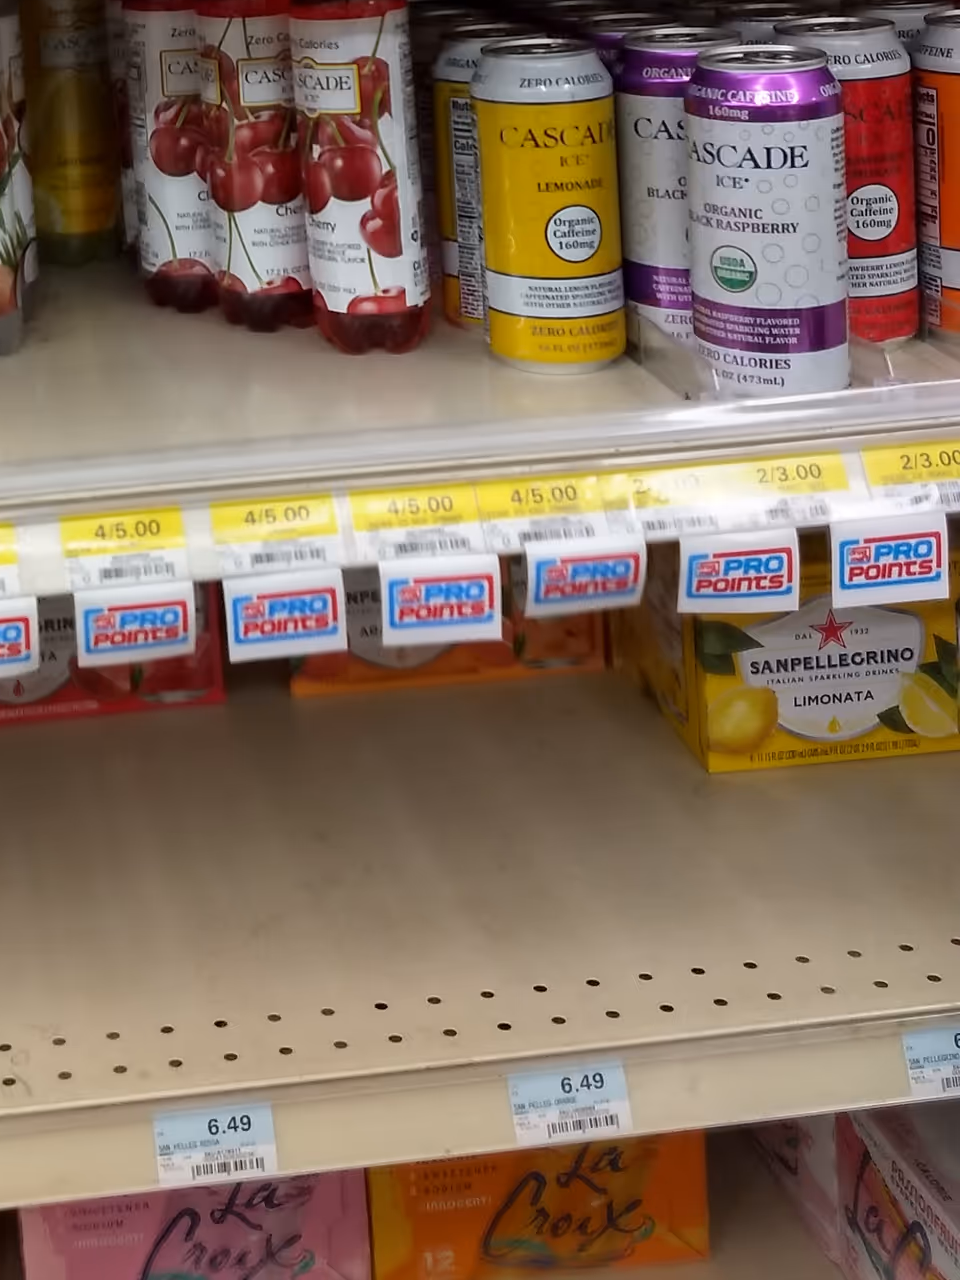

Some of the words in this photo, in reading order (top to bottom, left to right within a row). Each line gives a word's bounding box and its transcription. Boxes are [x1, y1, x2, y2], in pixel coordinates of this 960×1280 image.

[247, 34, 274, 47] Zero
[298, 38, 340, 51] Calories
[854, 49, 903, 65] CALORIES
[518, 76, 553, 89] ZERO
[555, 72, 604, 88] CALORIES
[708, 104, 750, 120] 160mg
[536, 178, 604, 193] LEMONADE
[850, 193, 894, 209] Organic
[703, 202, 763, 220] ORGANIC
[849, 205, 895, 218] Caffeine
[553, 216, 596, 233] Organic
[715, 219, 800, 234] RASPBERRY
[854, 217, 893, 230] 160mg
[553, 227, 597, 239] Caffeine
[558, 239, 596, 251] 160mg
[719, 256, 746, 269] USDA
[756, 317, 801, 327] FLAVORED
[765, 336, 799, 345] FLAVOR
[775, 327, 801, 336] WATER
[723, 353, 792, 371] CALORIES
[736, 370, 786, 388] (473mL)
[757, 463, 822, 484] 2/3.00
[510, 485, 578, 506] 4/5.00
[387, 495, 454, 516] 4/5.00
[244, 505, 311, 526] 4/5.00
[94, 519, 161, 540] 4/5.00
[873, 539, 933, 562] PRO
[722, 555, 785, 576] PRO
[848, 558, 933, 583] POINTS
[695, 574, 785, 593] POINTS
[794, 633, 813, 641] DAL
[850, 628, 870, 637] 1932
[749, 647, 915, 676] SANPELLEGRINO
[766, 676, 805, 686] ITALIAN
[808, 671, 861, 683] SPARKLING
[865, 667, 901, 677] DRINKS
[793, 690, 875, 708] LIMONATA
[560, 1072, 606, 1094] 6.49
[207, 1114, 253, 1136] 6.49
[556, 1141, 628, 1195] La
[209, 1181, 283, 1232] La
[481, 1170, 646, 1263] Croix
